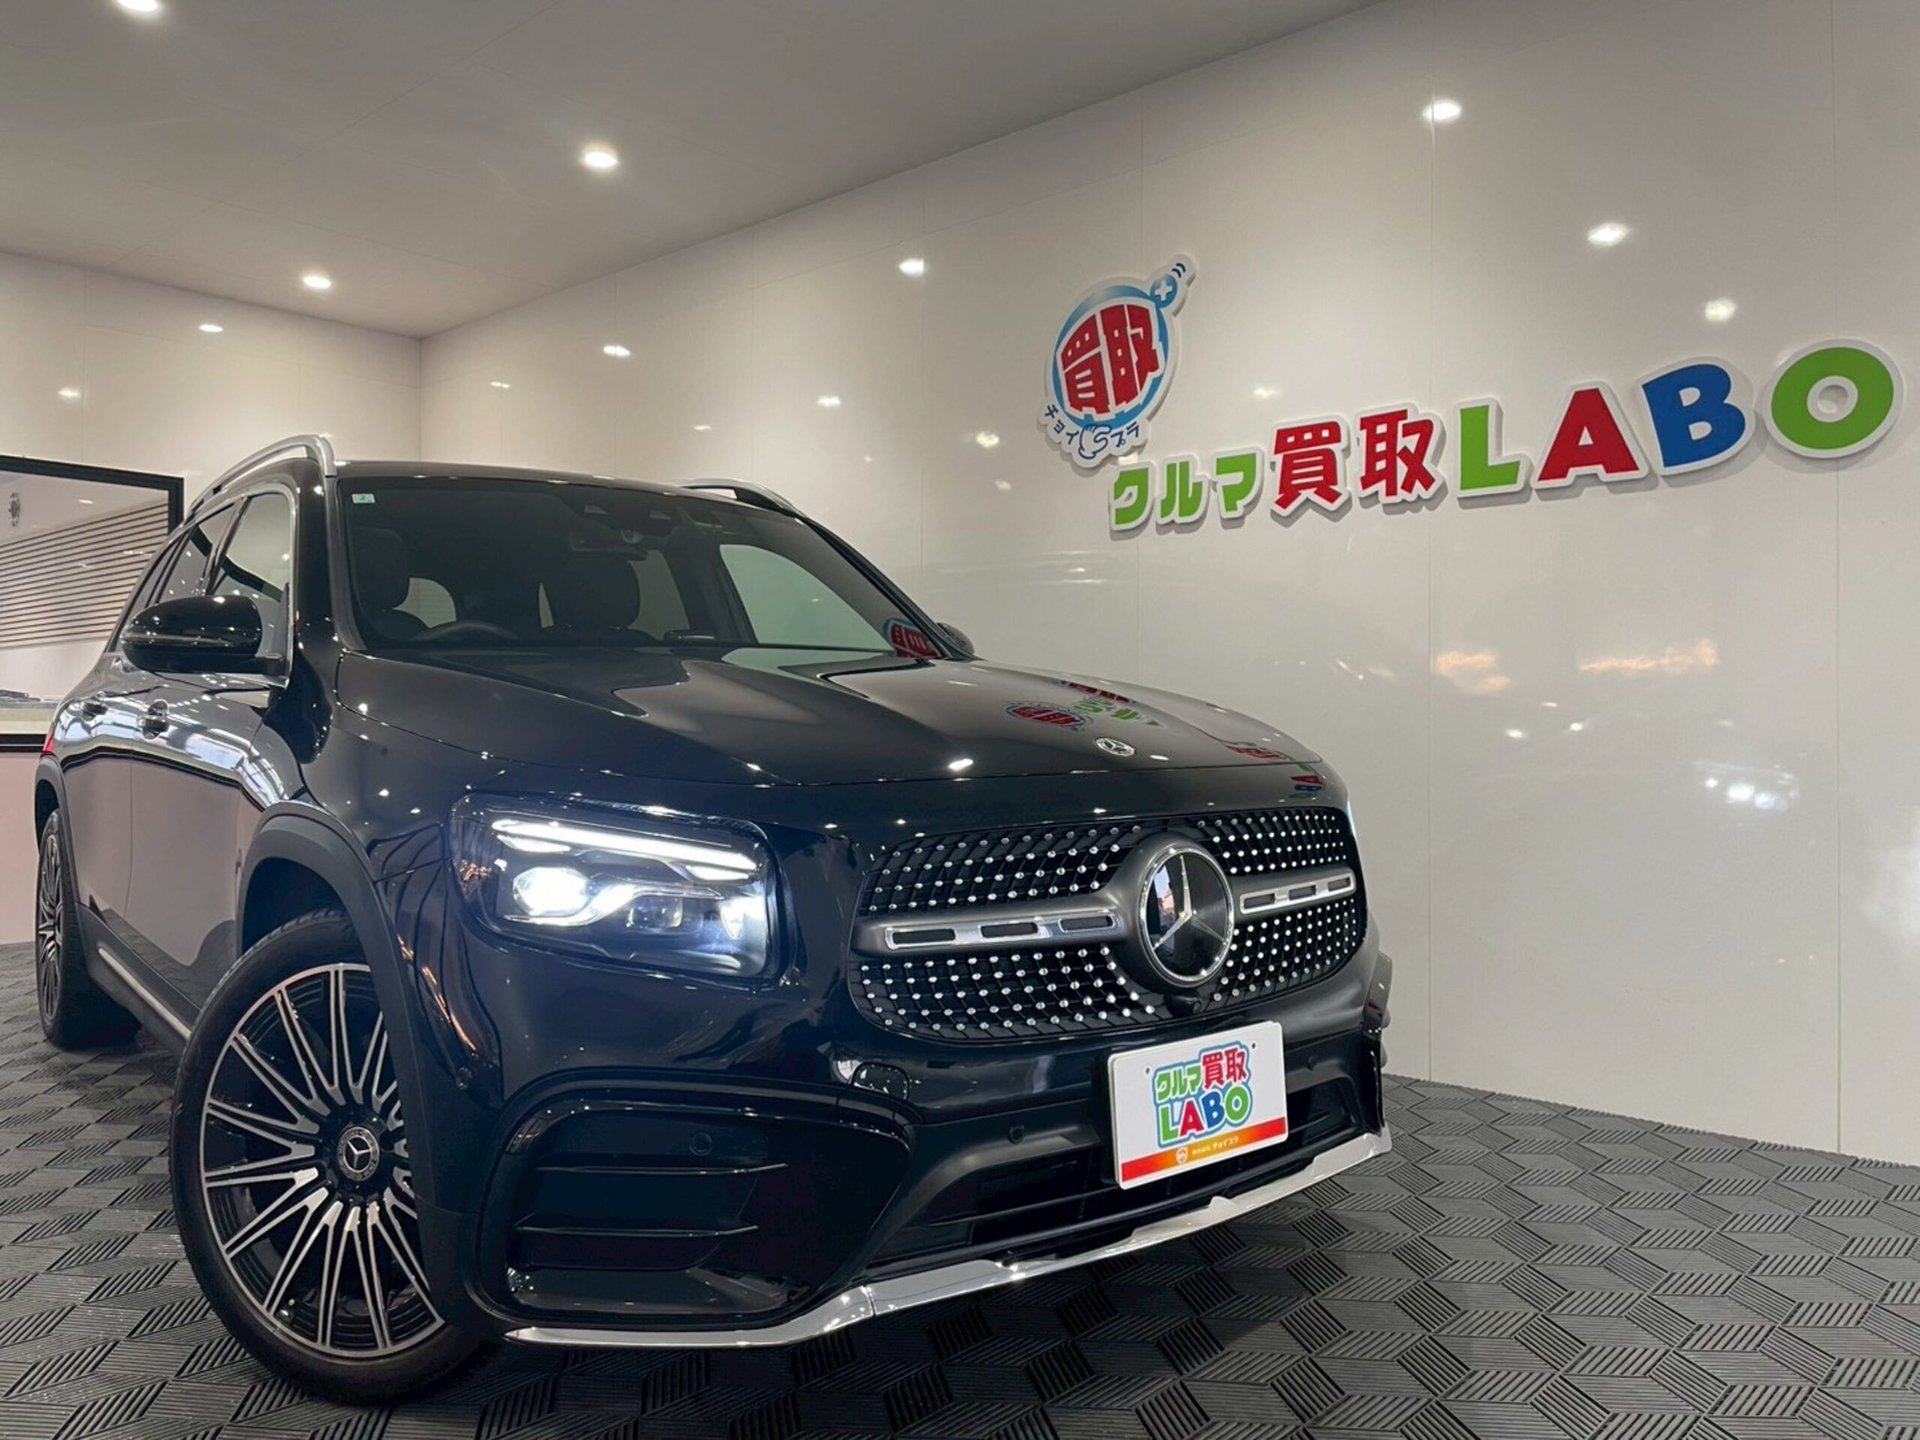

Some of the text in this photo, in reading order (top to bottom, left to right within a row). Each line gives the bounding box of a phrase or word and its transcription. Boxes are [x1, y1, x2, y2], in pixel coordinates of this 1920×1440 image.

[1061, 304, 1159, 414] 買取
[1157, 1049, 1247, 1101] クルマ買取
[1160, 1086, 1249, 1141] LABO
